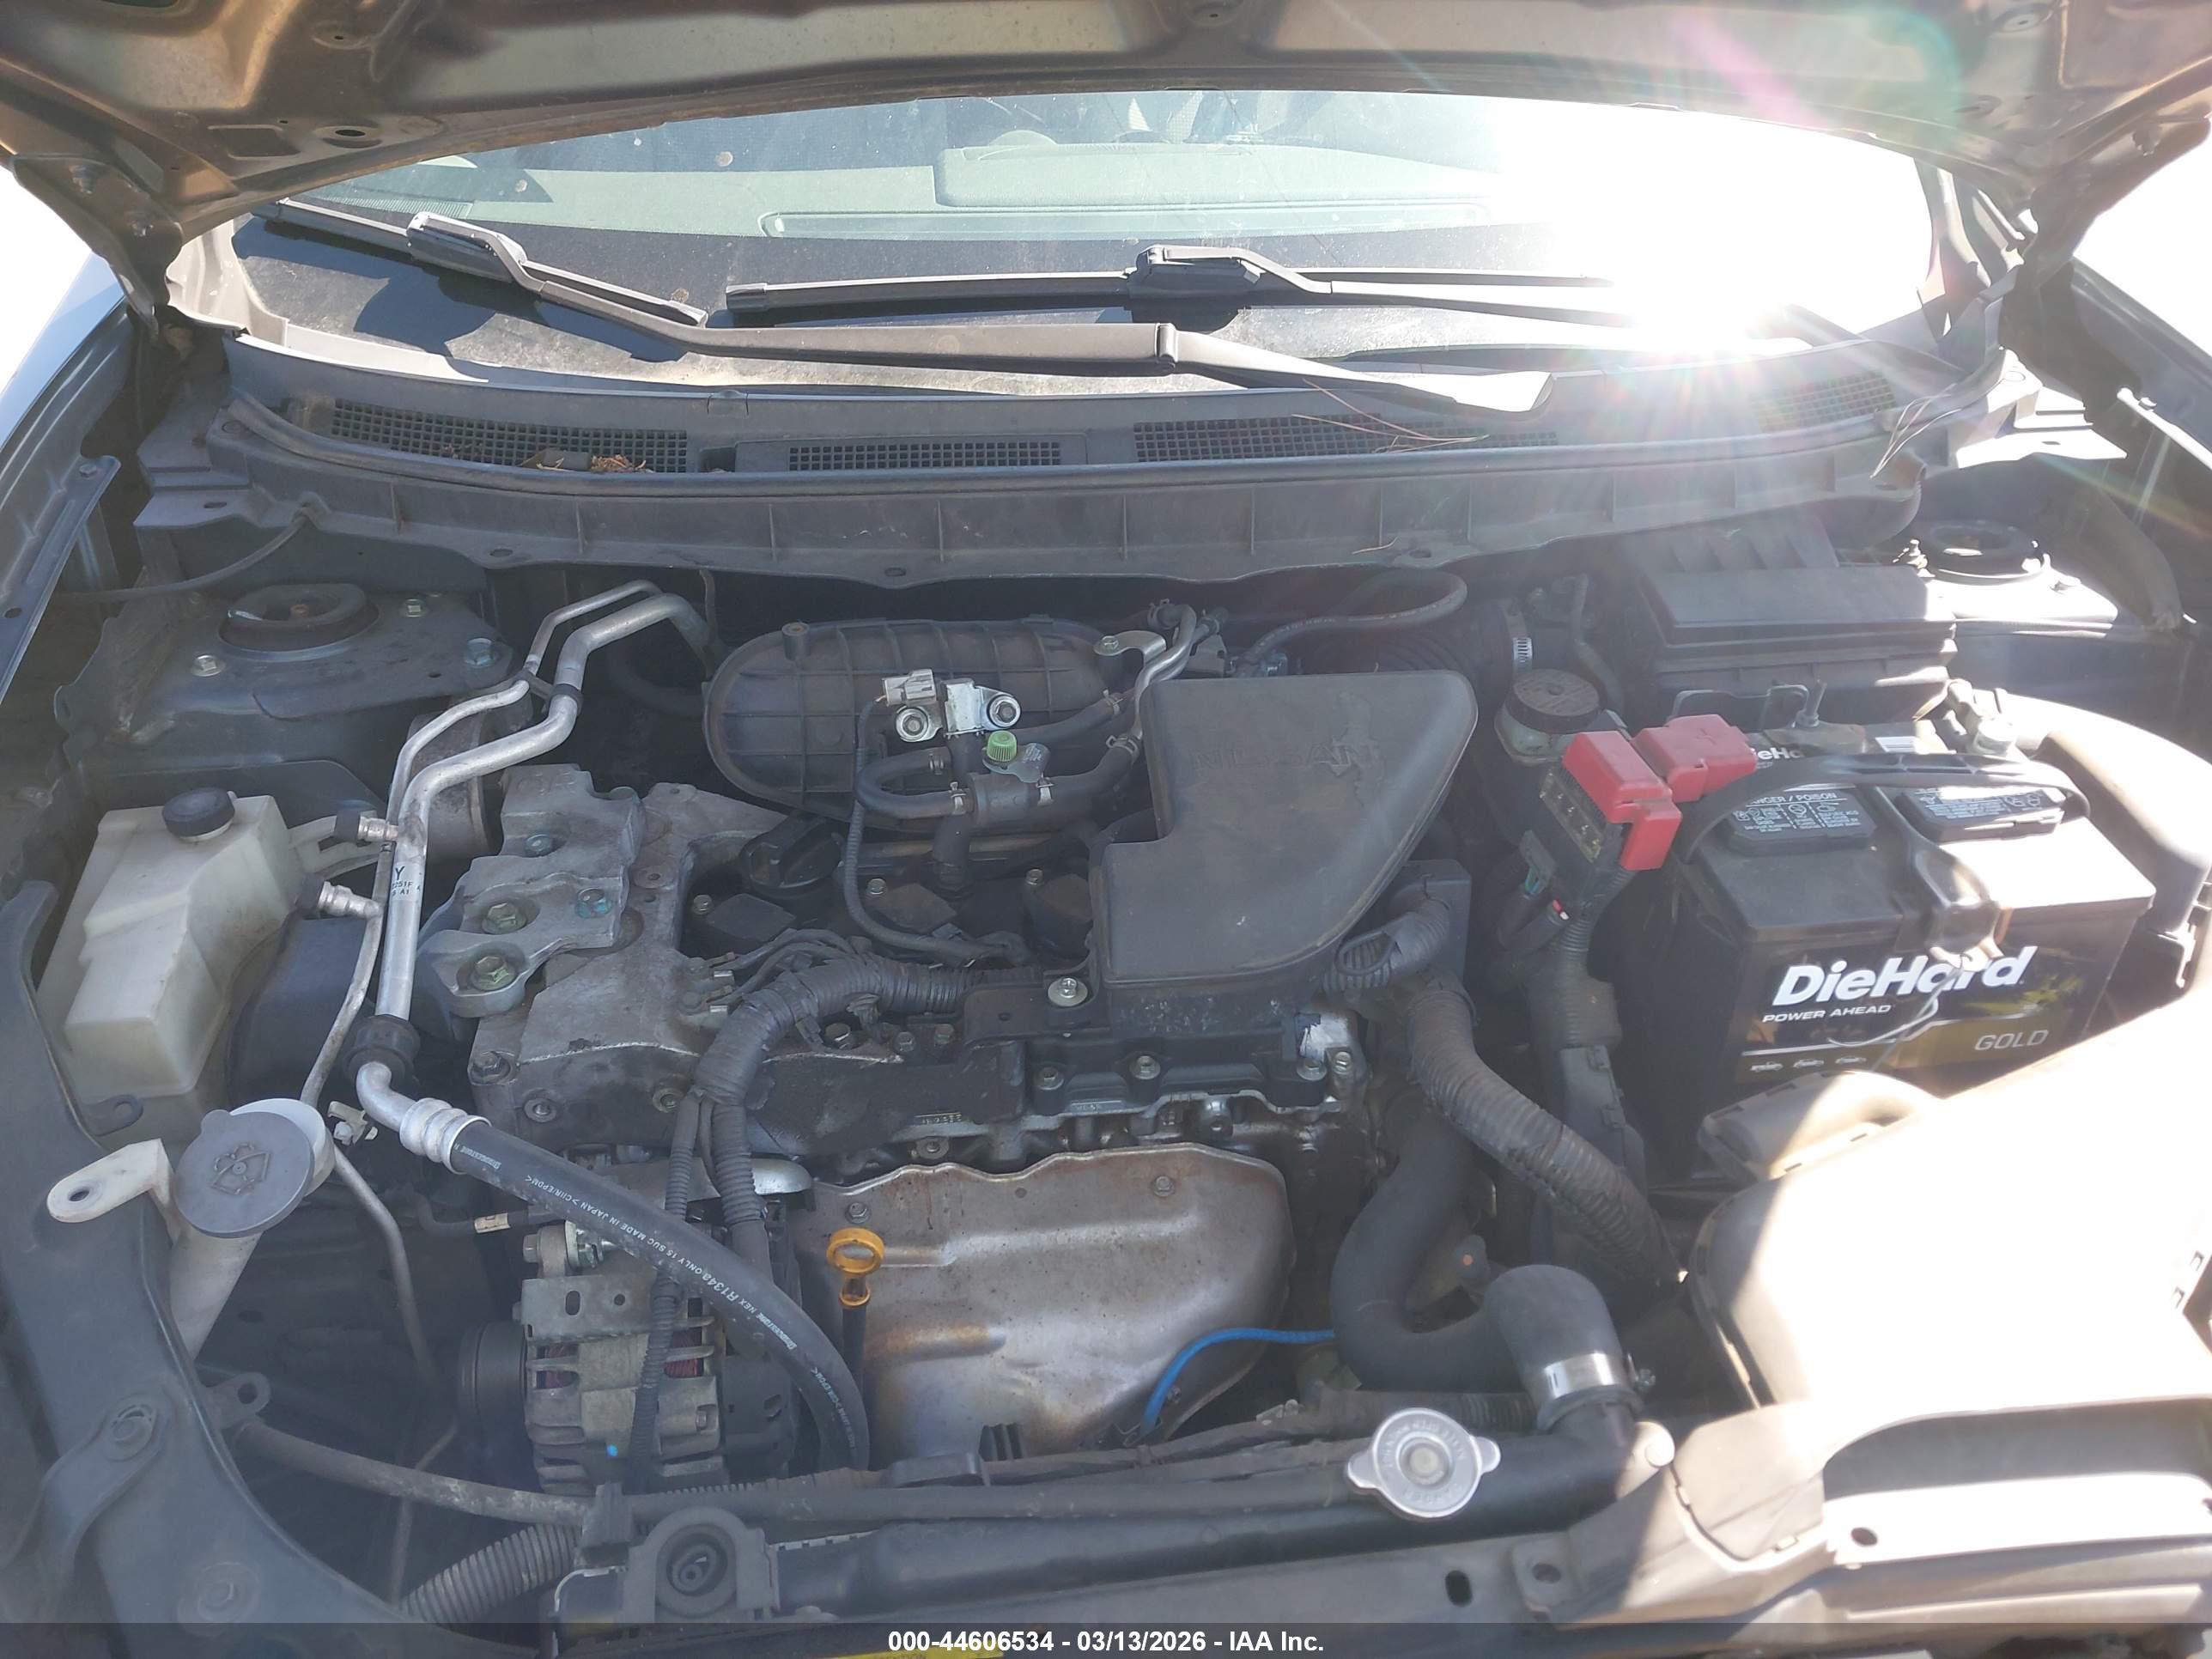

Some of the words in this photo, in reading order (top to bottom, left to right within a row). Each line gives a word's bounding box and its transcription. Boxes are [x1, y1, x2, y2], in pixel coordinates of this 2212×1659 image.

[395, 866, 405, 880] Y
[1762, 1010, 1826, 1023] POWER
[1830, 1005, 1892, 1017] AHEAD
[1975, 1030, 2049, 1050] GOLD
[580, 1201, 610, 1220] JAPAN
[609, 1216, 624, 1227] IN
[620, 1223, 647, 1242] MADE
[678, 1257, 702, 1275] ONLY
[702, 1272, 739, 1302] R134a
[738, 1297, 758, 1314] NEX
